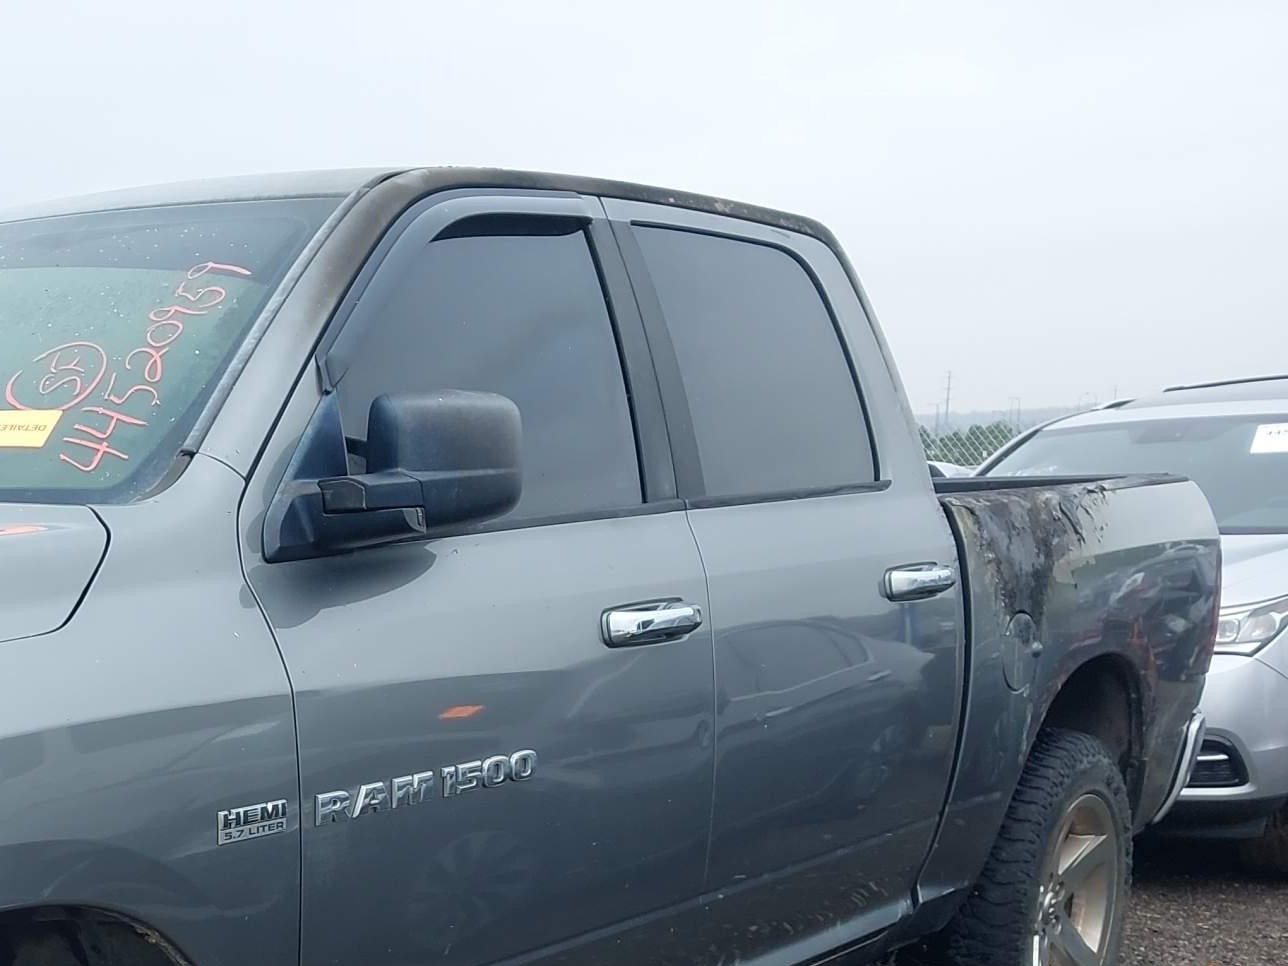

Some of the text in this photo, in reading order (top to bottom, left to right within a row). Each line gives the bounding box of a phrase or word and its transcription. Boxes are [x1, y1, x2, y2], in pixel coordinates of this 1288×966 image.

[60, 261, 252, 472] 44520959
[217, 798, 289, 831] HEMI
[314, 748, 539, 827] RAM 1500
[223, 820, 286, 841] 5.7 LITER
